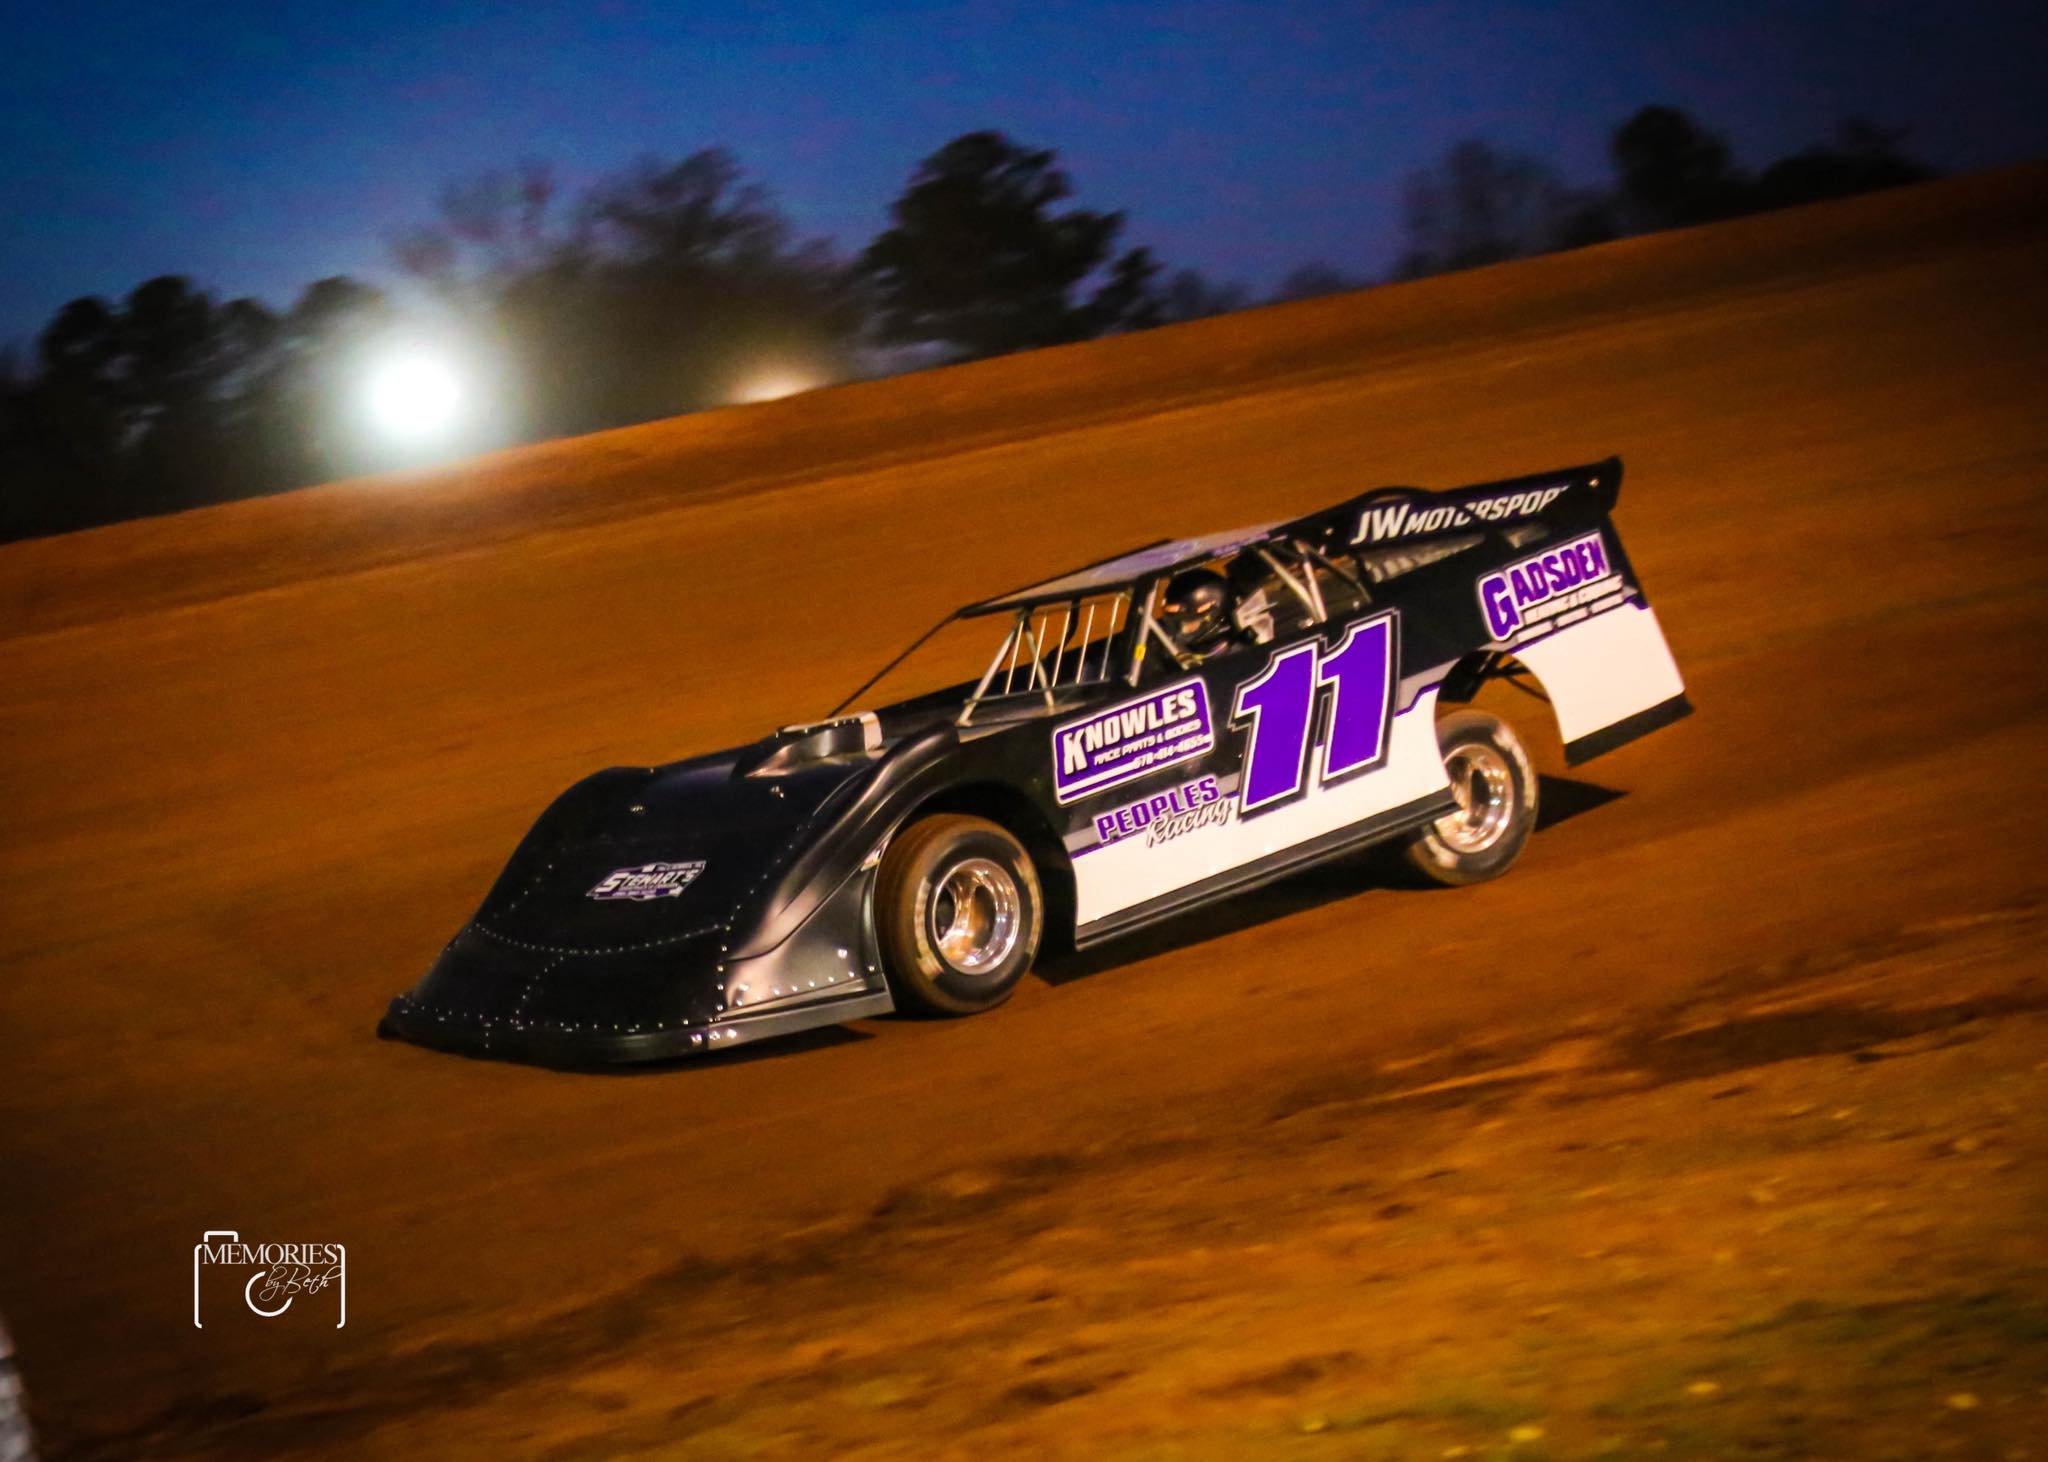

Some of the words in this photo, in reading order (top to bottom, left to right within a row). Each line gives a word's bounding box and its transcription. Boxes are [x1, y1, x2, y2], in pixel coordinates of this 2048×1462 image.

[1350, 503, 1410, 544] JW
[1402, 485, 1569, 536] MOTORSPOR
[1481, 539, 1605, 638] GADSDEN
[1062, 688, 1197, 776] KNOWLES
[1232, 611, 1394, 816] 11
[1094, 747, 1122, 766] RACE
[1122, 735, 1156, 755] PARTS
[1096, 777, 1220, 841] PEOPLES
[1146, 799, 1232, 848] Racing
